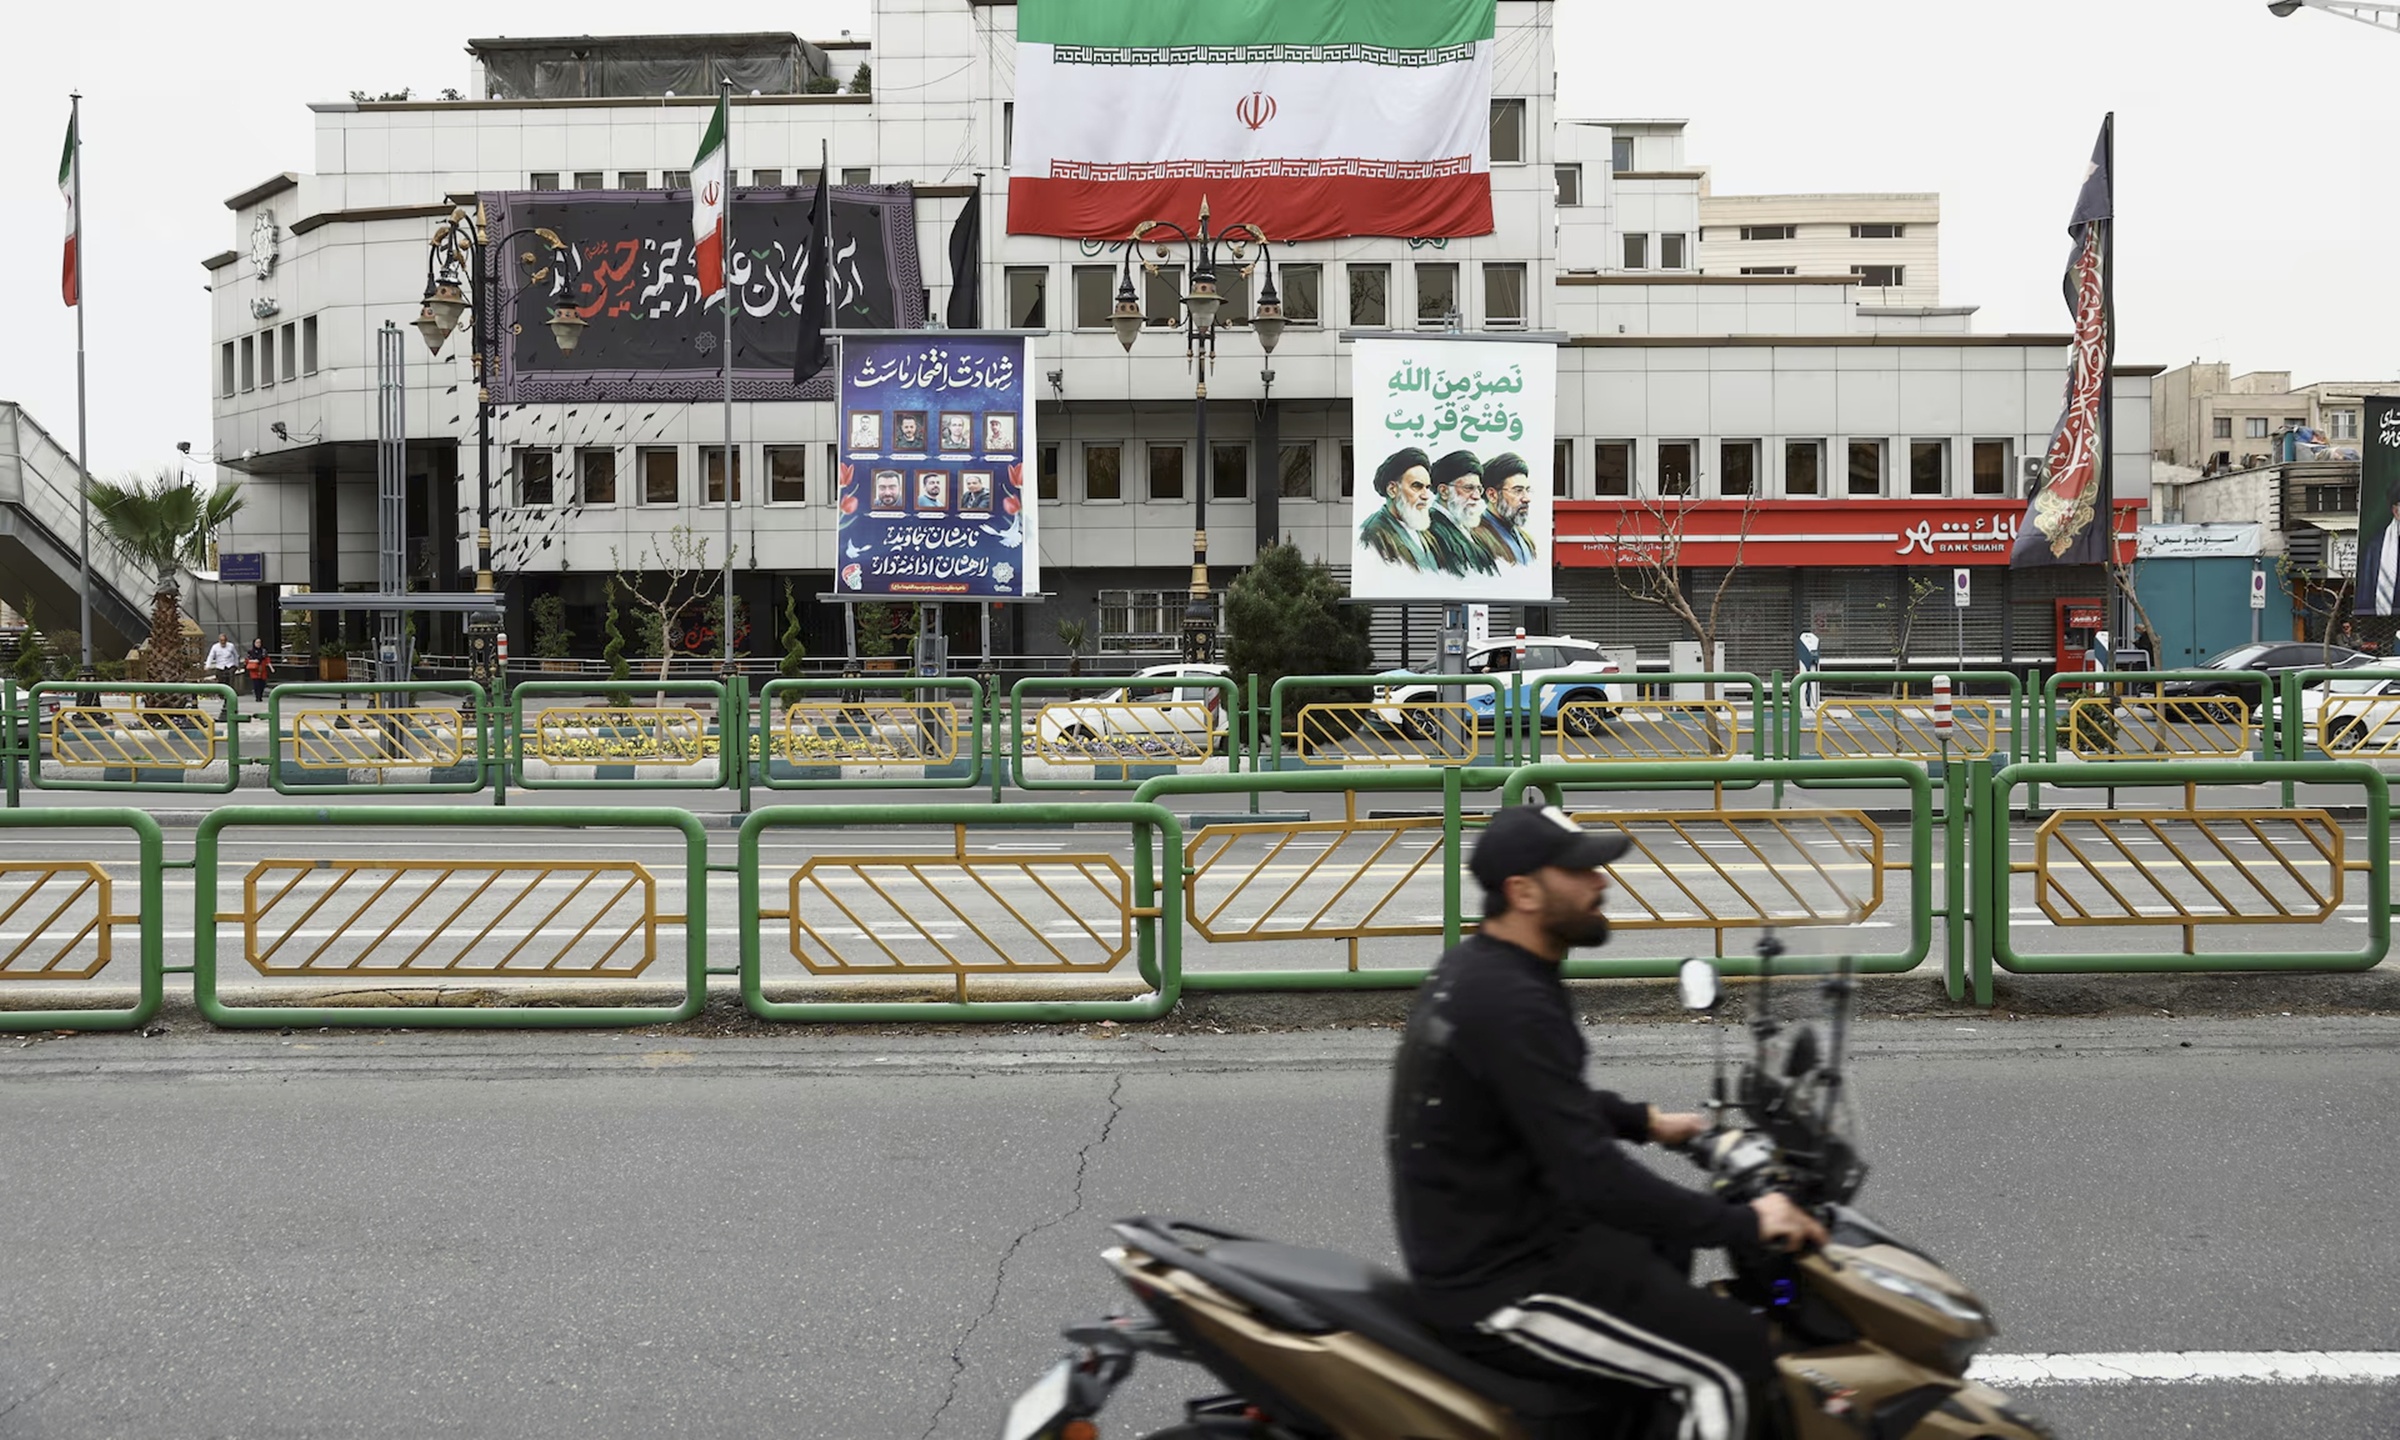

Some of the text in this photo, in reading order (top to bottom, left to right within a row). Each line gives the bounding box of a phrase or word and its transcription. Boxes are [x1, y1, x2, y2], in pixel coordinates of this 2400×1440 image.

[1895, 519, 1970, 555] شهر
[1939, 544, 2005, 552] BANK SHAHR
